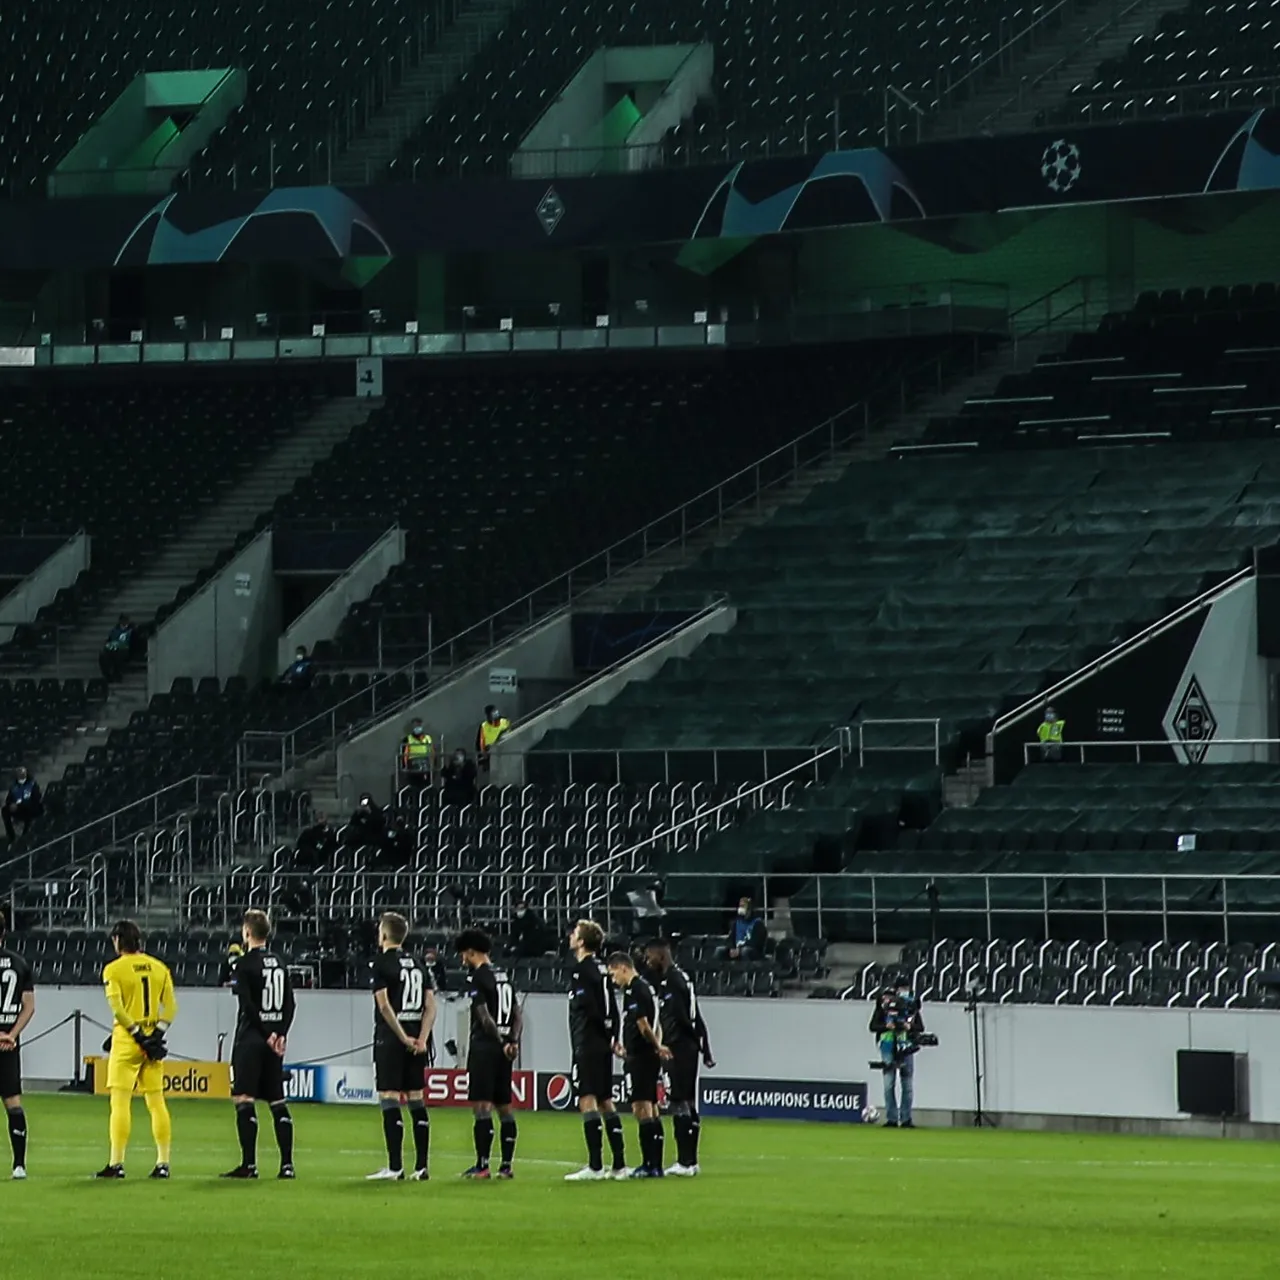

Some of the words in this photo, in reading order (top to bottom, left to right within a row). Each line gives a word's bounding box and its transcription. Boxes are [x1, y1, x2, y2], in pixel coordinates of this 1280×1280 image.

[141, 975, 150, 1017] 1
[262, 967, 285, 1011] 30
[400, 967, 423, 1011] 28
[496, 982, 513, 1025] 19
[163, 1067, 208, 1092] pedia
[703, 1089, 736, 1106] UEFA
[739, 1090, 810, 1108] CHAMPIONS
[813, 1093, 860, 1110] LEAGUE
